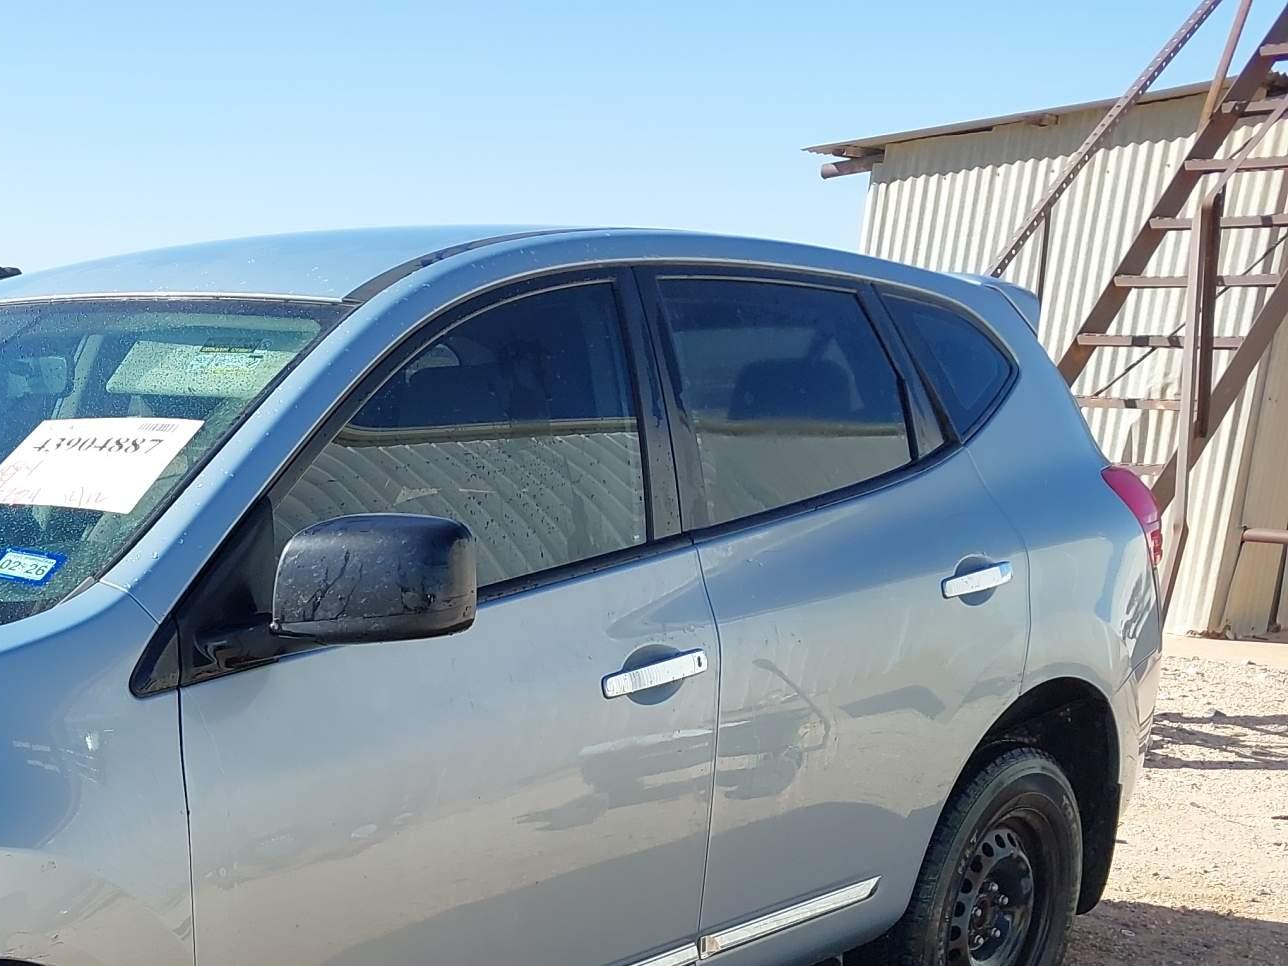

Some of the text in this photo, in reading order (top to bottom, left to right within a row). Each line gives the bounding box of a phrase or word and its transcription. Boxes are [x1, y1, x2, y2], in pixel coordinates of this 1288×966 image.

[32, 436, 165, 455] 43904887
[0, 558, 21, 571] 02
[24, 562, 49, 576] 26
